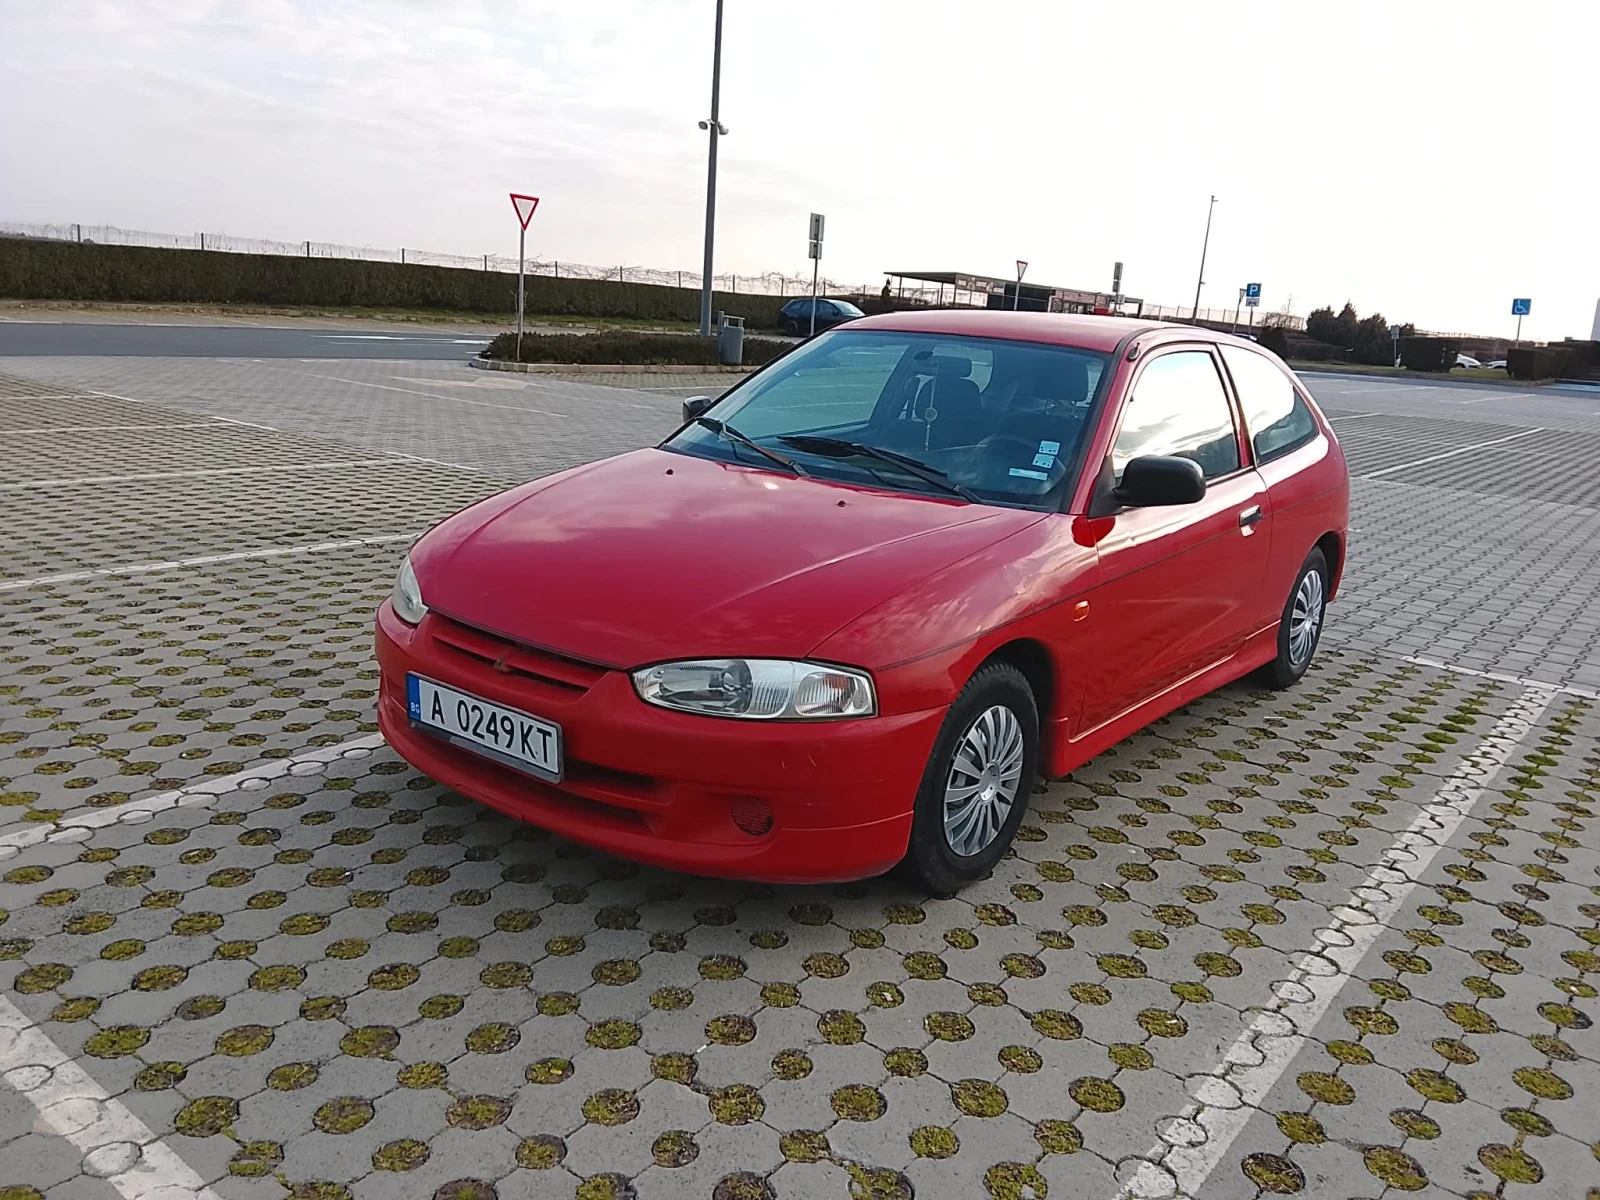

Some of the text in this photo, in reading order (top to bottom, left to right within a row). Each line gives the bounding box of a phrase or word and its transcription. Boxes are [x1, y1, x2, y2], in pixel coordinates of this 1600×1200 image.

[1250, 285, 1258, 296] P
[410, 701, 420, 714] BG
[431, 690, 445, 725] A
